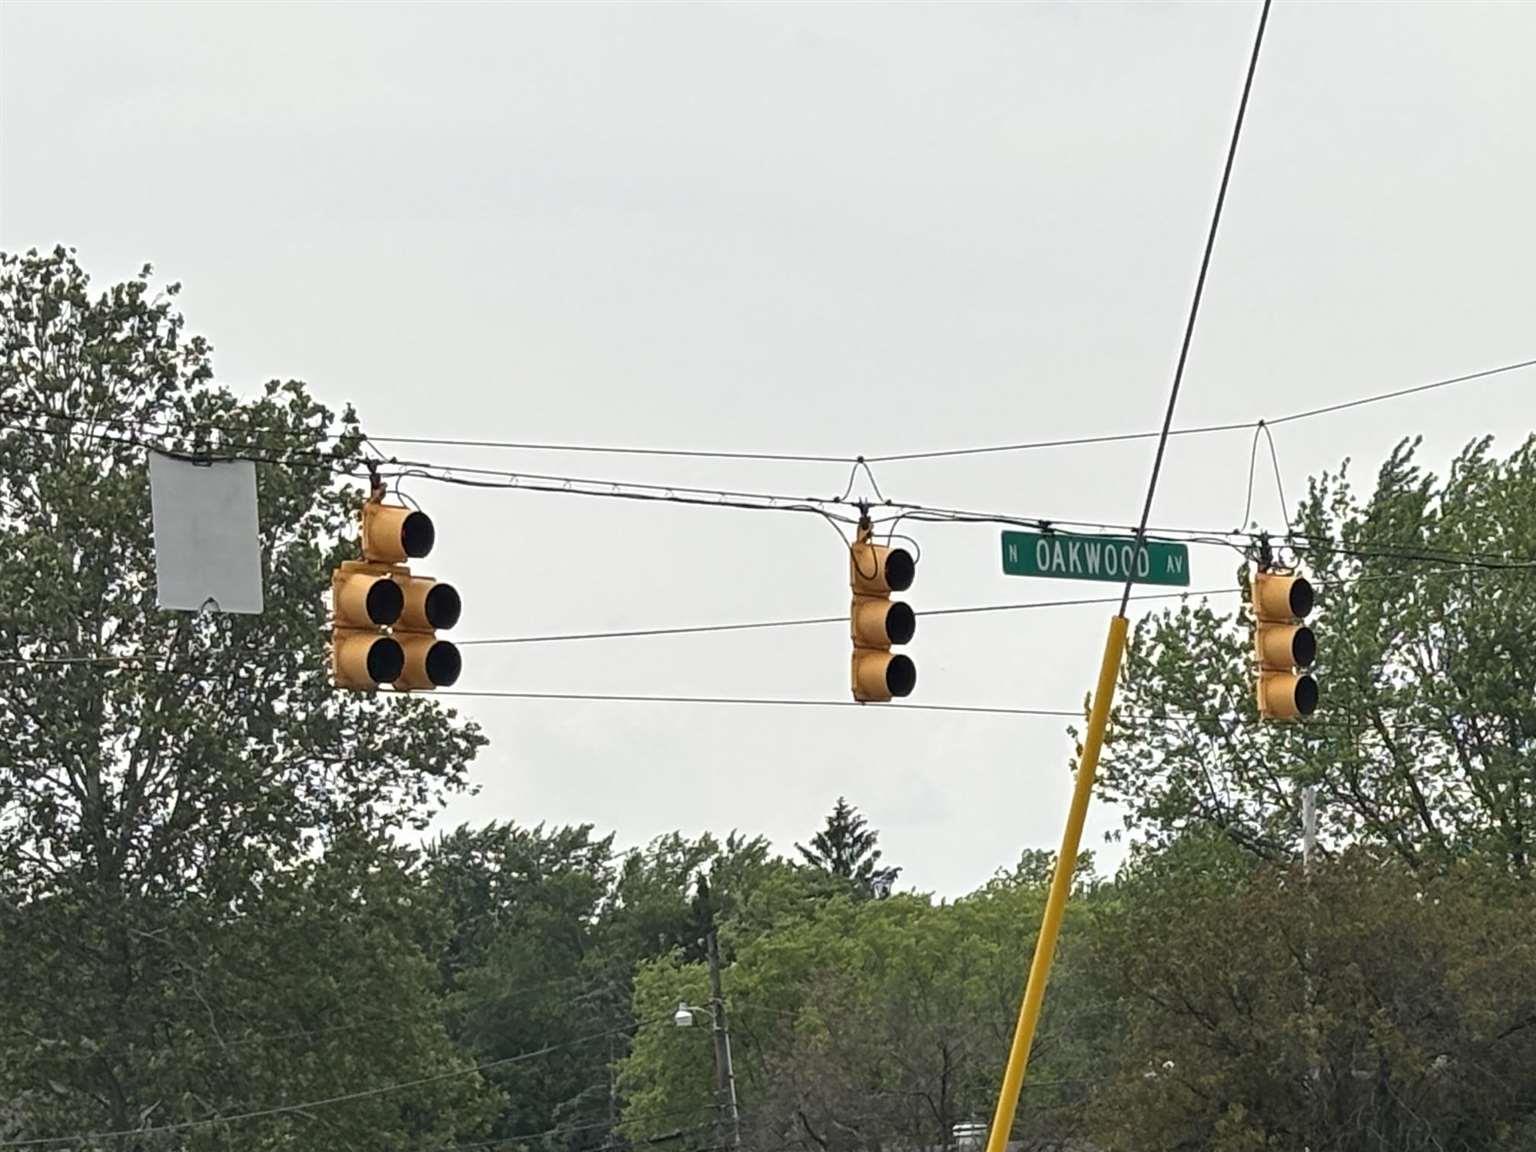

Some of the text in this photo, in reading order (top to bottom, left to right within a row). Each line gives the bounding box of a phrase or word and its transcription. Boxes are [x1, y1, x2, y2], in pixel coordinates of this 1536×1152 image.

[1009, 539, 1183, 577] N OAKWOOD AV
